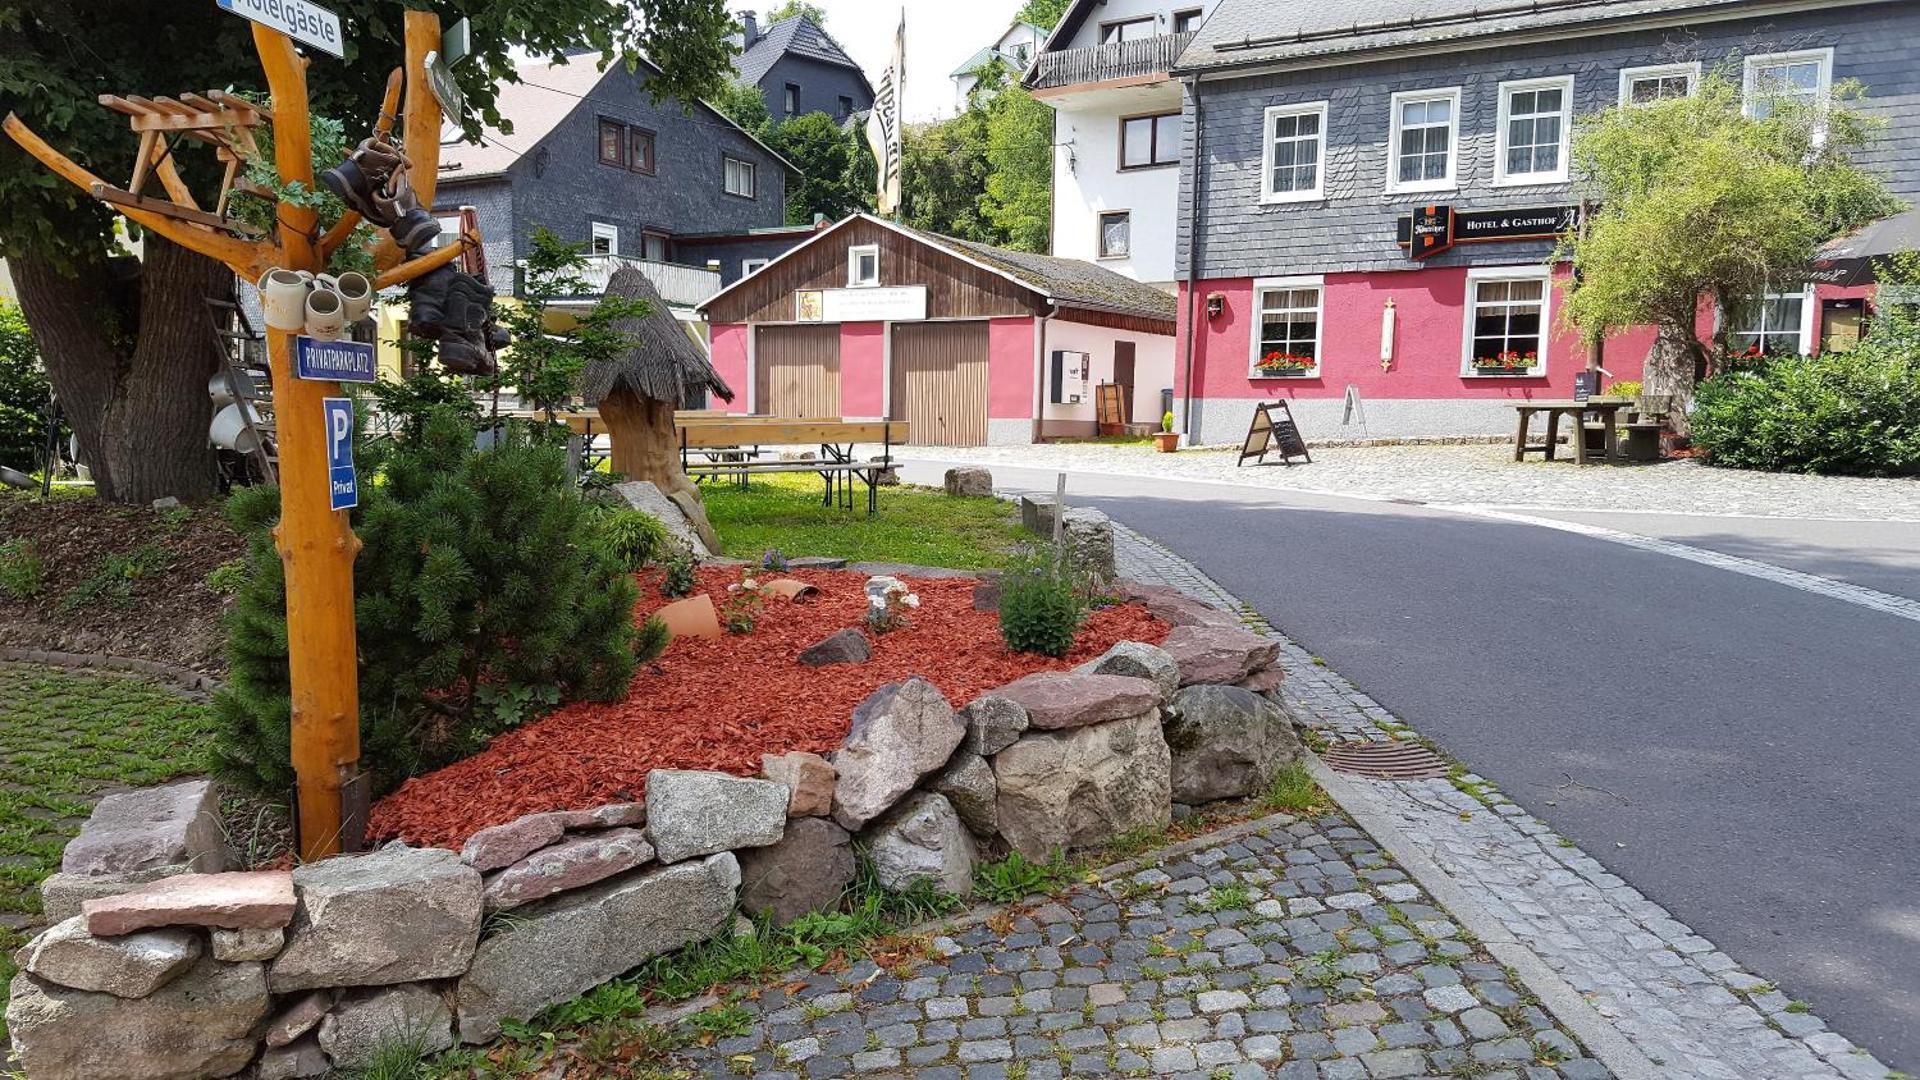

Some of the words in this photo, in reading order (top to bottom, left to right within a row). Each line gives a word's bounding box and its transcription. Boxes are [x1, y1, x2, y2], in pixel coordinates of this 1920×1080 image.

[237, 0, 335, 42] otelgäste
[1466, 220, 1499, 230] HOTEL
[1500, 218, 1511, 228] &
[1512, 216, 1558, 227] GASTHOF
[305, 346, 370, 374] PRIVATPARKPLATZ
[332, 408, 349, 460] P
[333, 479, 354, 496] Privat
